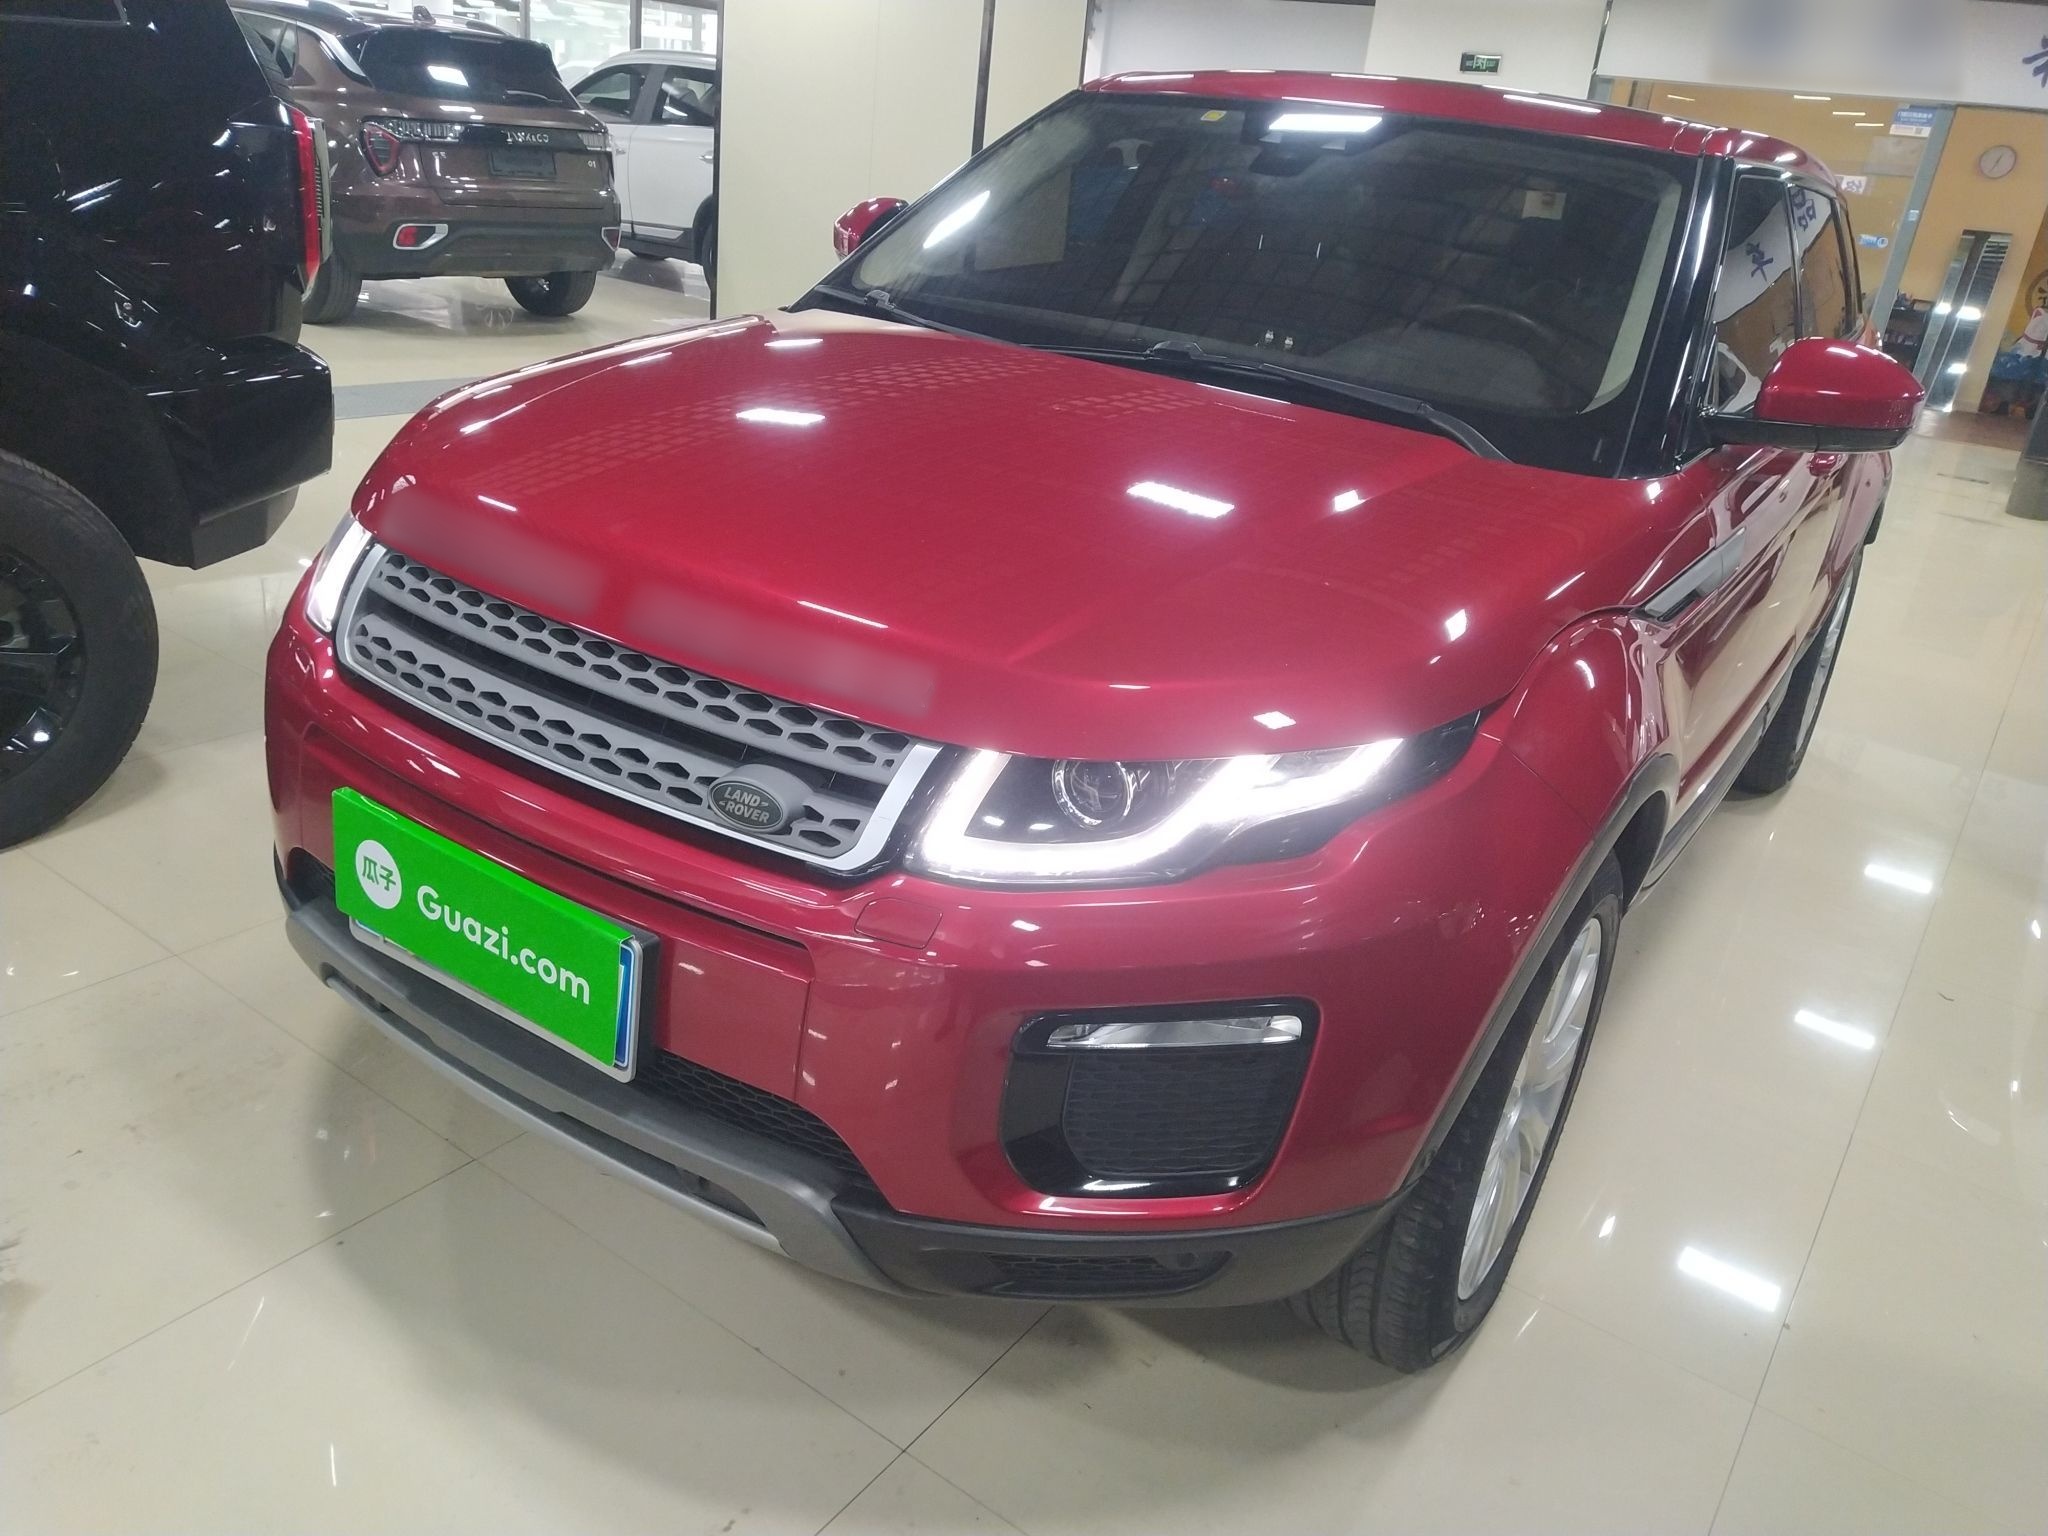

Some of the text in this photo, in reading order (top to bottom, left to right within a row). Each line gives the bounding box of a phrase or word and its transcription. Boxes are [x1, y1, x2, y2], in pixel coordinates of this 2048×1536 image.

[724, 786, 761, 808] LAND
[725, 800, 770, 824] ROVER
[361, 855, 590, 1005] 瓜子 Guazi.com
